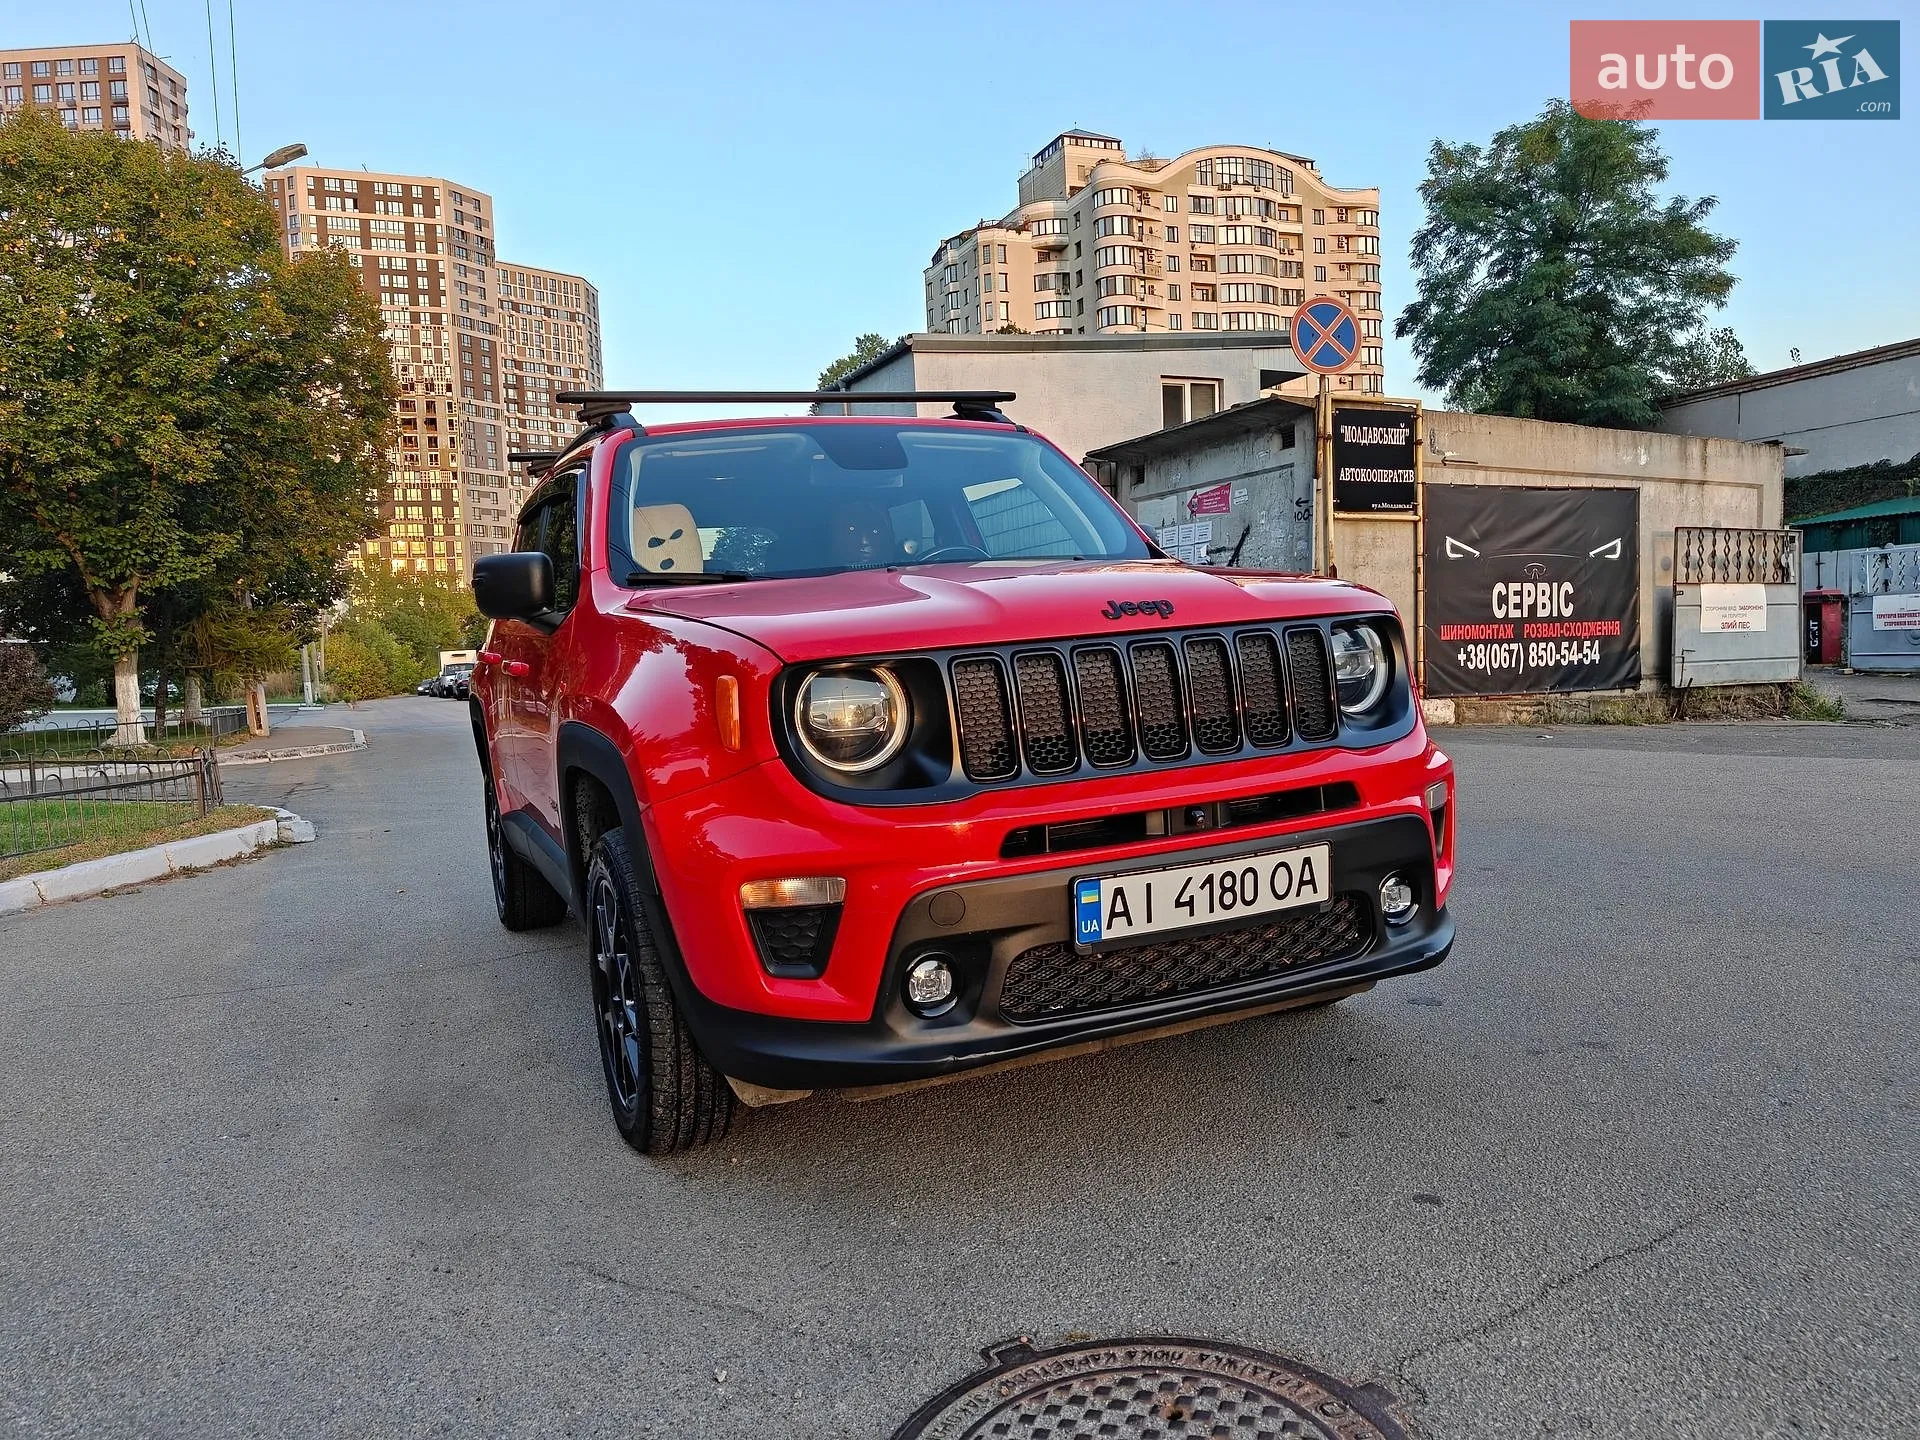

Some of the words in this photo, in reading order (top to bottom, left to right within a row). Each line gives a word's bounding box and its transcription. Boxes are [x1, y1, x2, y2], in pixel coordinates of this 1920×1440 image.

[1339, 467, 1415, 483] АВТОКООПЕРАТИВ
[1101, 599, 1175, 620] Jeep
[1491, 581, 1575, 619] СЕРВІС
[1440, 624, 1514, 641] ШИНОМОНТАЖ
[1523, 621, 1621, 639] РОЗВАЛ-СХОДЖЕННЯ
[1720, 620, 1737, 630] ЗЛИЙ
[1738, 621, 1751, 630] ПЕС
[1457, 643, 1525, 675] +38(067)
[1528, 640, 1601, 668] 850-54-54
[1105, 882, 1153, 931] AI
[1173, 866, 1259, 917] 4180
[1269, 856, 1319, 901] OA
[1081, 919, 1100, 934] UA
